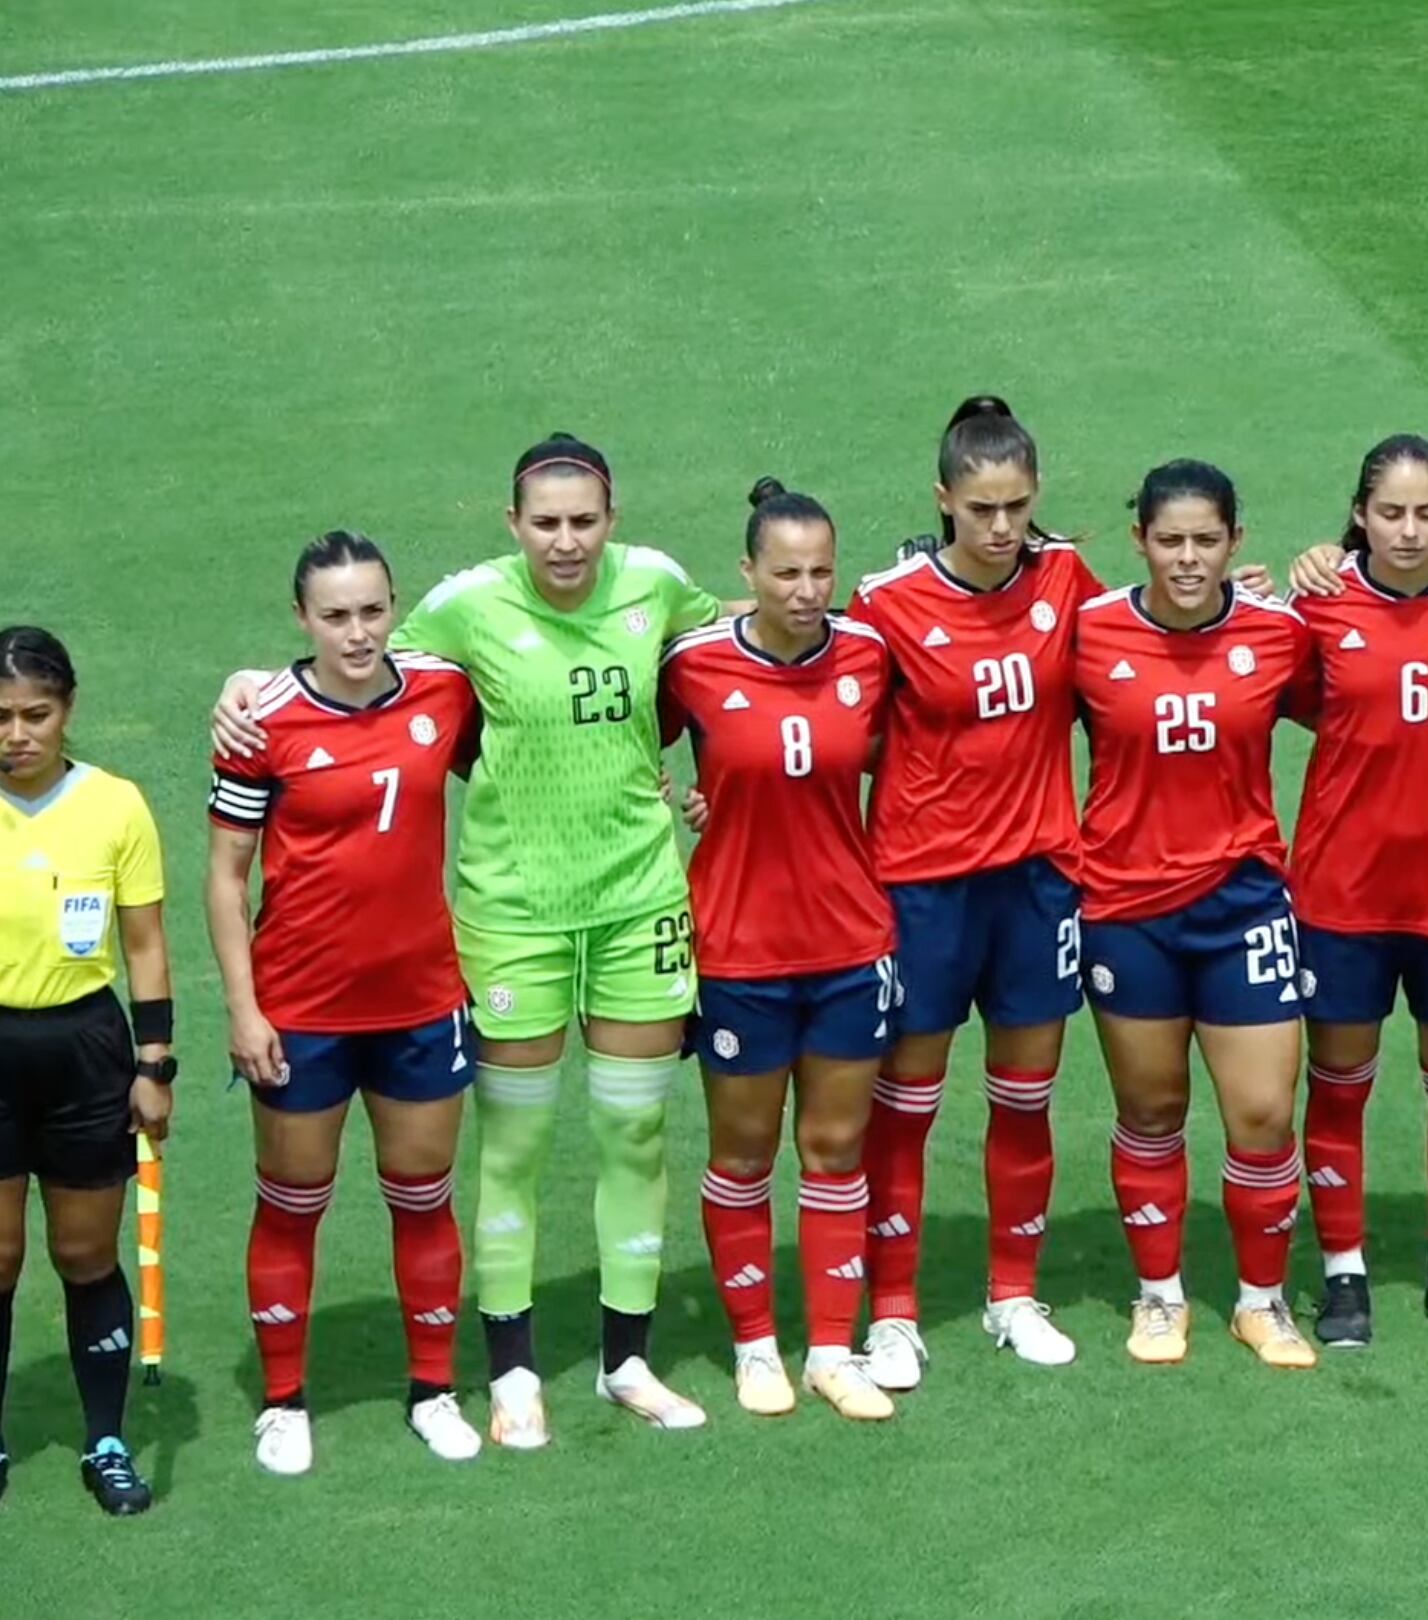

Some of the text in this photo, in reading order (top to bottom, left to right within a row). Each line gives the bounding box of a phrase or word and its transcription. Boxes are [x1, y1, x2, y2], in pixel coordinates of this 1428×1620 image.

[569, 666, 631, 724] 23
[972, 652, 1034, 719] 20
[780, 715, 812, 777] 8
[1154, 692, 1216, 754] 25
[372, 768, 400, 832] 7
[64, 897, 100, 913] FIFA
[655, 911, 692, 974] 23
[1058, 917, 1081, 979] 2
[1244, 917, 1295, 984] 25
